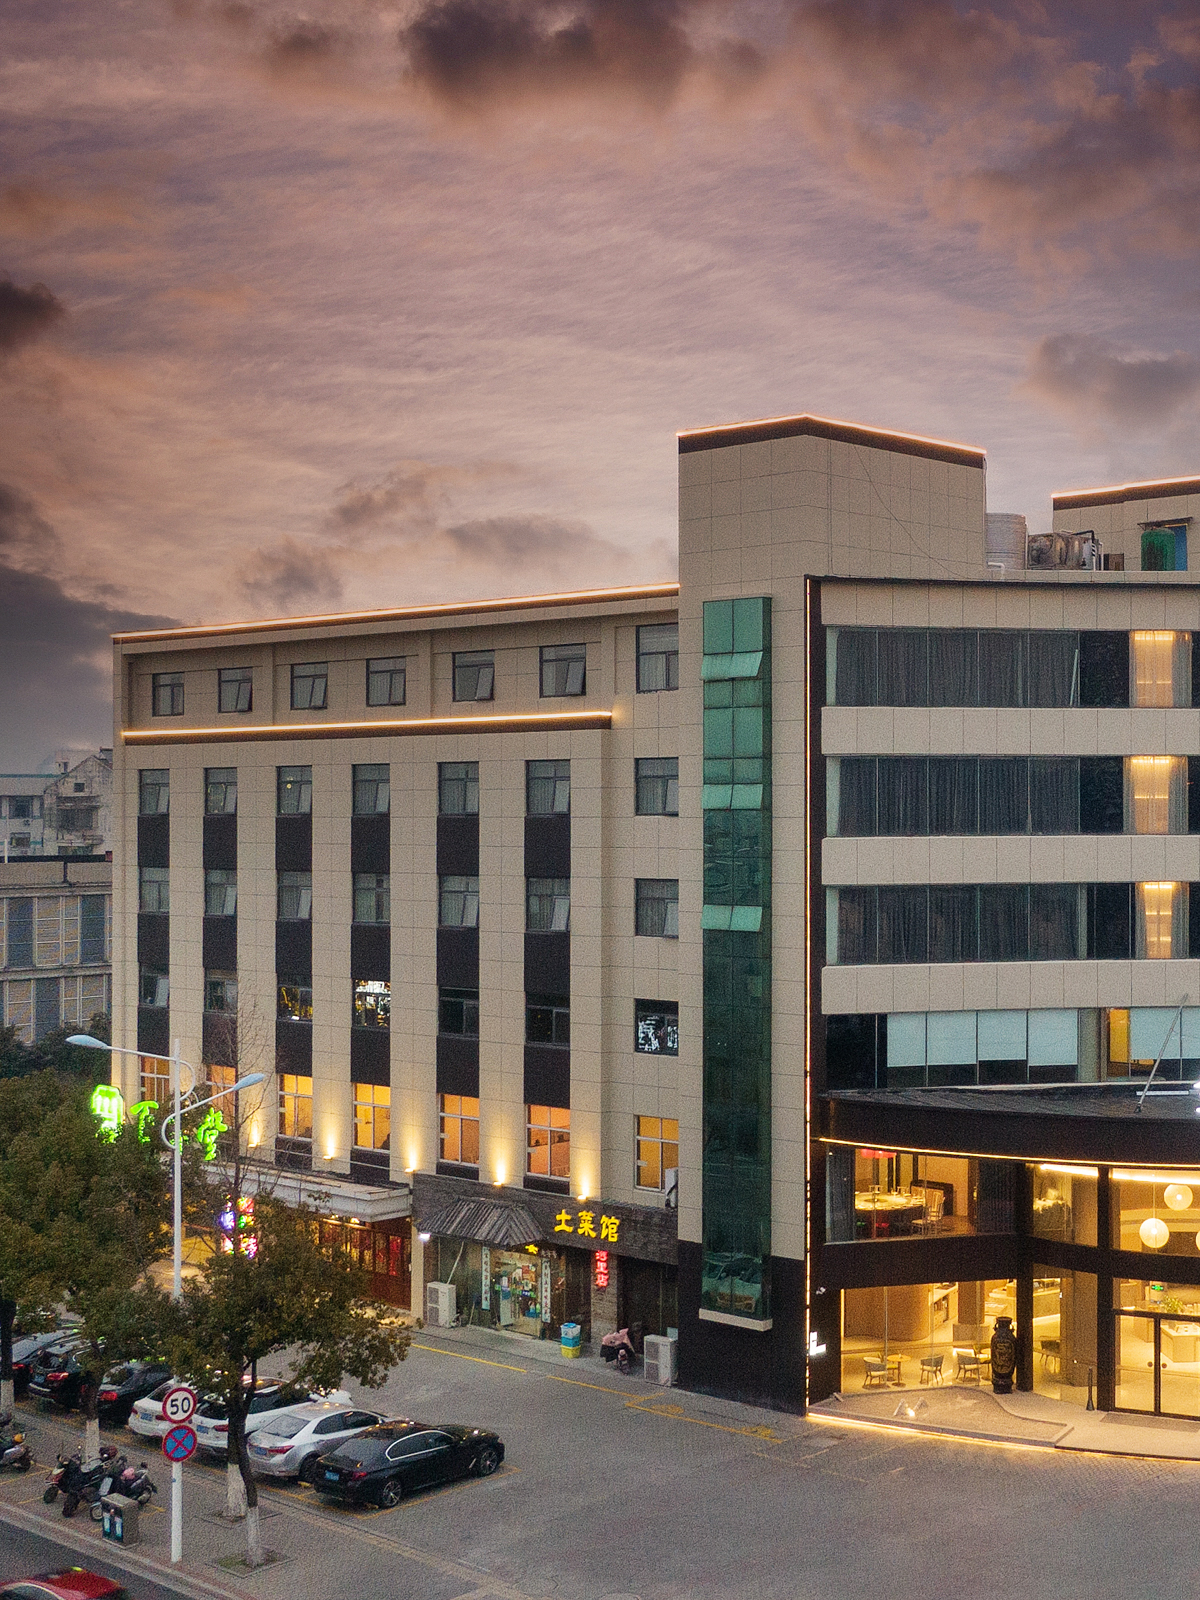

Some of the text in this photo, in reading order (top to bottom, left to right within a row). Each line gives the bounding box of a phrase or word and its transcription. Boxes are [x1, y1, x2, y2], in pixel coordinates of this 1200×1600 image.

[554, 1209, 620, 1243] 土菜馆
[170, 1396, 191, 1416] 50
